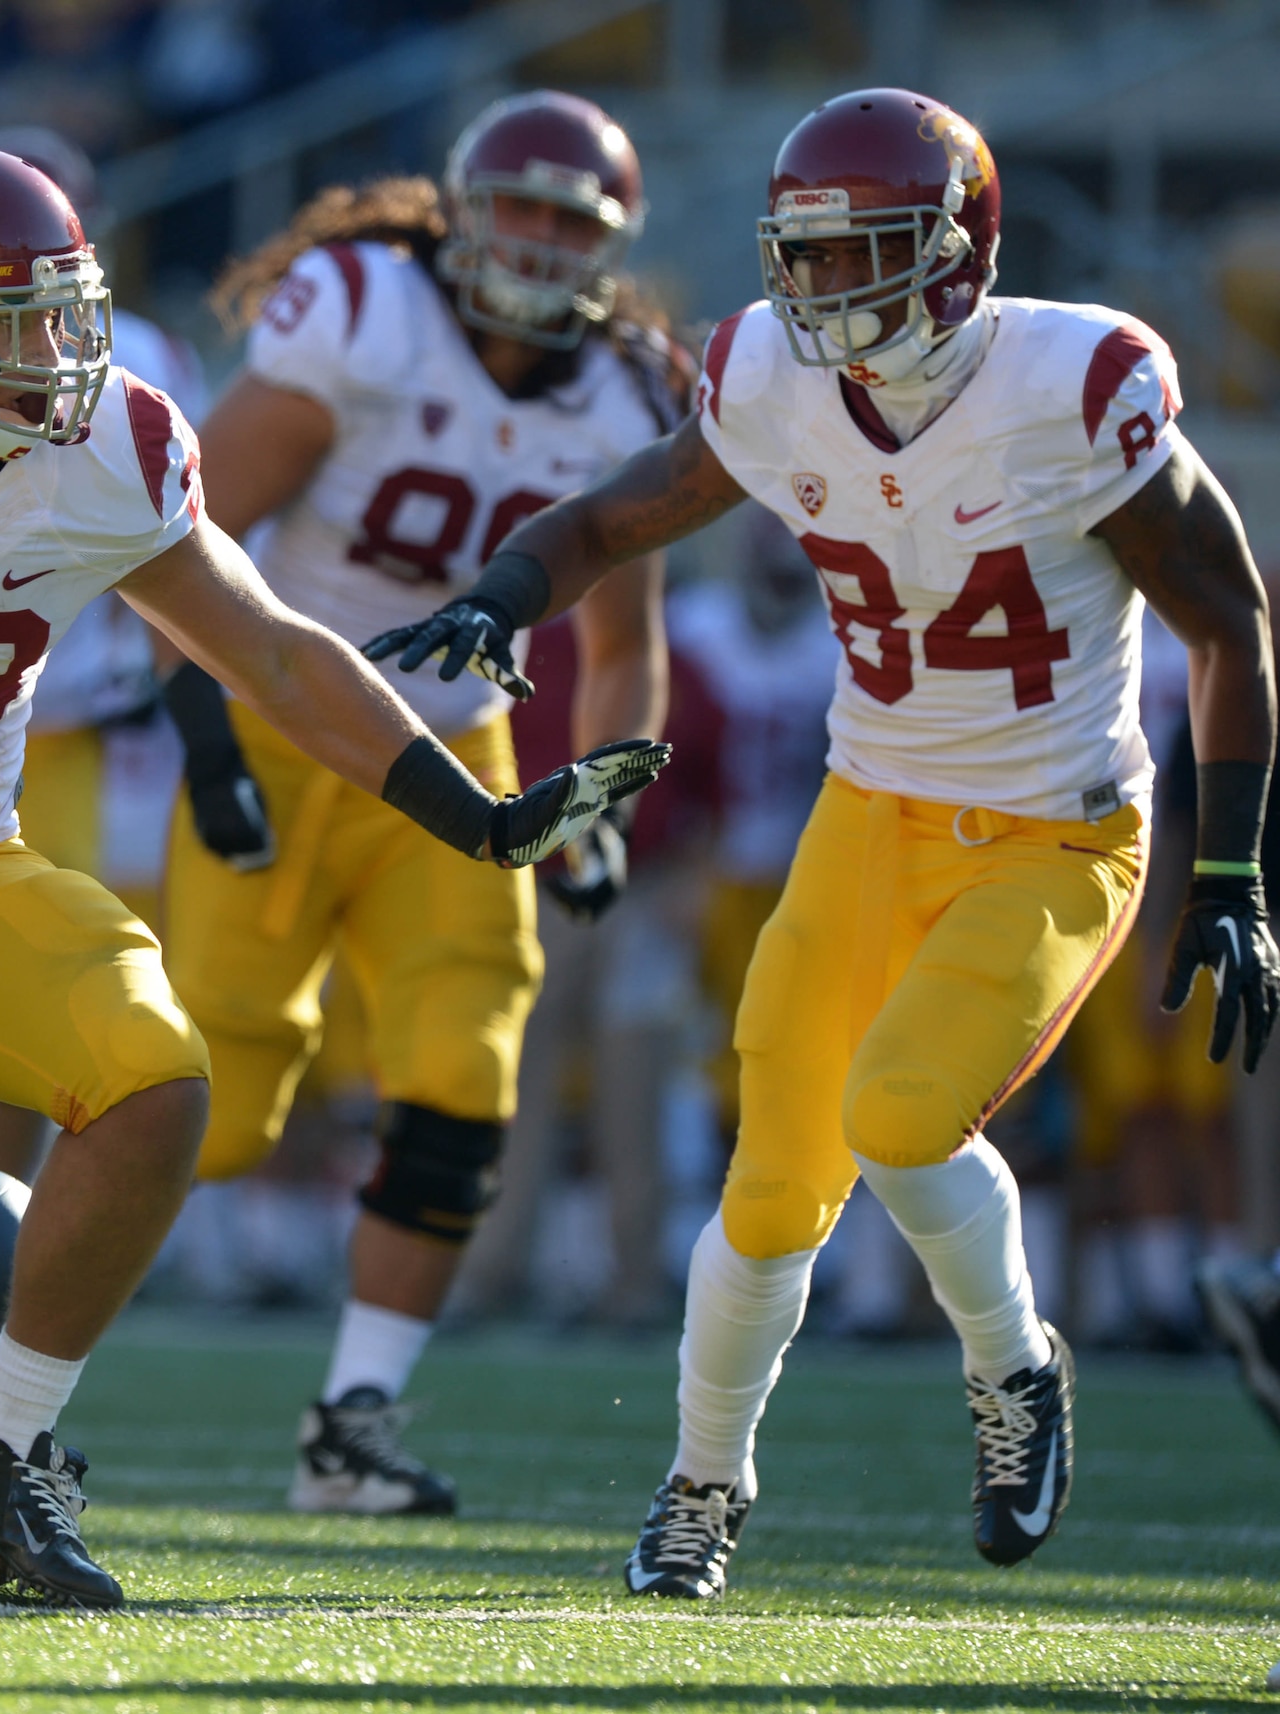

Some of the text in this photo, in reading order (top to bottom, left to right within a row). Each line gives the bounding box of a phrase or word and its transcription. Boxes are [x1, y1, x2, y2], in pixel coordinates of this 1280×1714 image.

[794, 192, 829, 205] USC
[880, 474, 903, 508] SC
[799, 531, 1070, 711] 84
